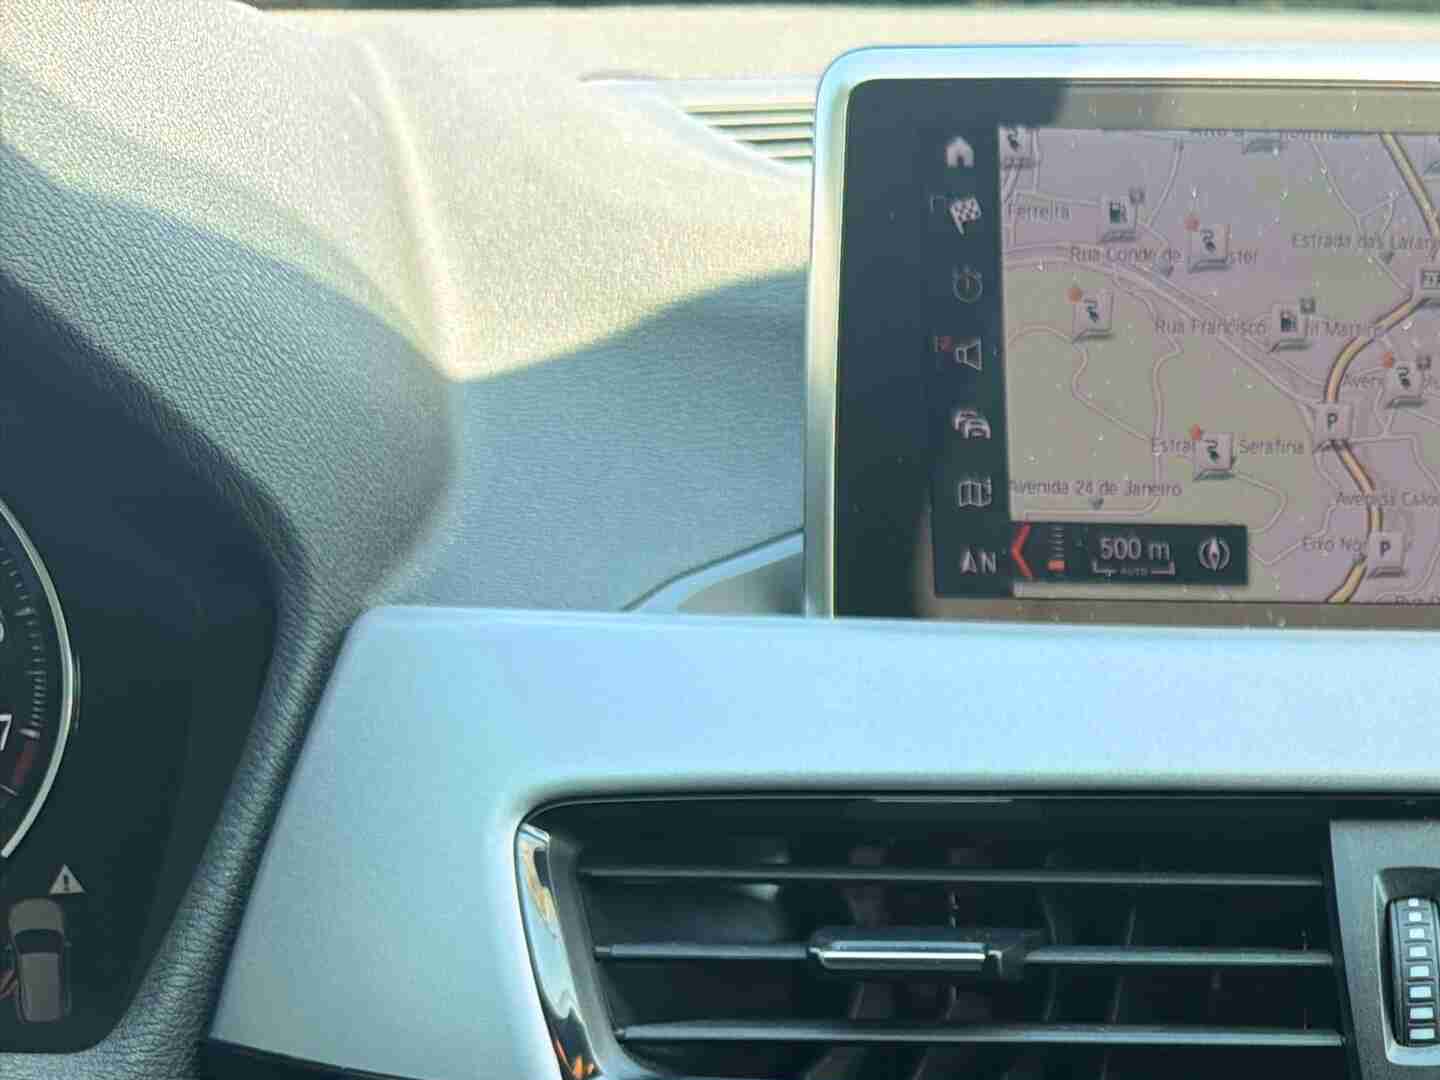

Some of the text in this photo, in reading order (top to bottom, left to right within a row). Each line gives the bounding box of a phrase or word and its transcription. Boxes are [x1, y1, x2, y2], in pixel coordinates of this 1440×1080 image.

[1291, 233, 1350, 250] Estrada
[1360, 233, 1385, 250] das
[1069, 246, 1099, 263] Rua
[1106, 246, 1157, 263] Conde
[1162, 246, 1182, 262] de
[1155, 318, 1185, 335] Rua
[1191, 318, 1267, 336] Francisco
[1238, 438, 1304, 454] Serafina
[1074, 480, 1094, 496] 24
[1100, 480, 1117, 496] de
[1123, 480, 1182, 497] Janeiro
[1100, 537, 1171, 560] 500 m
